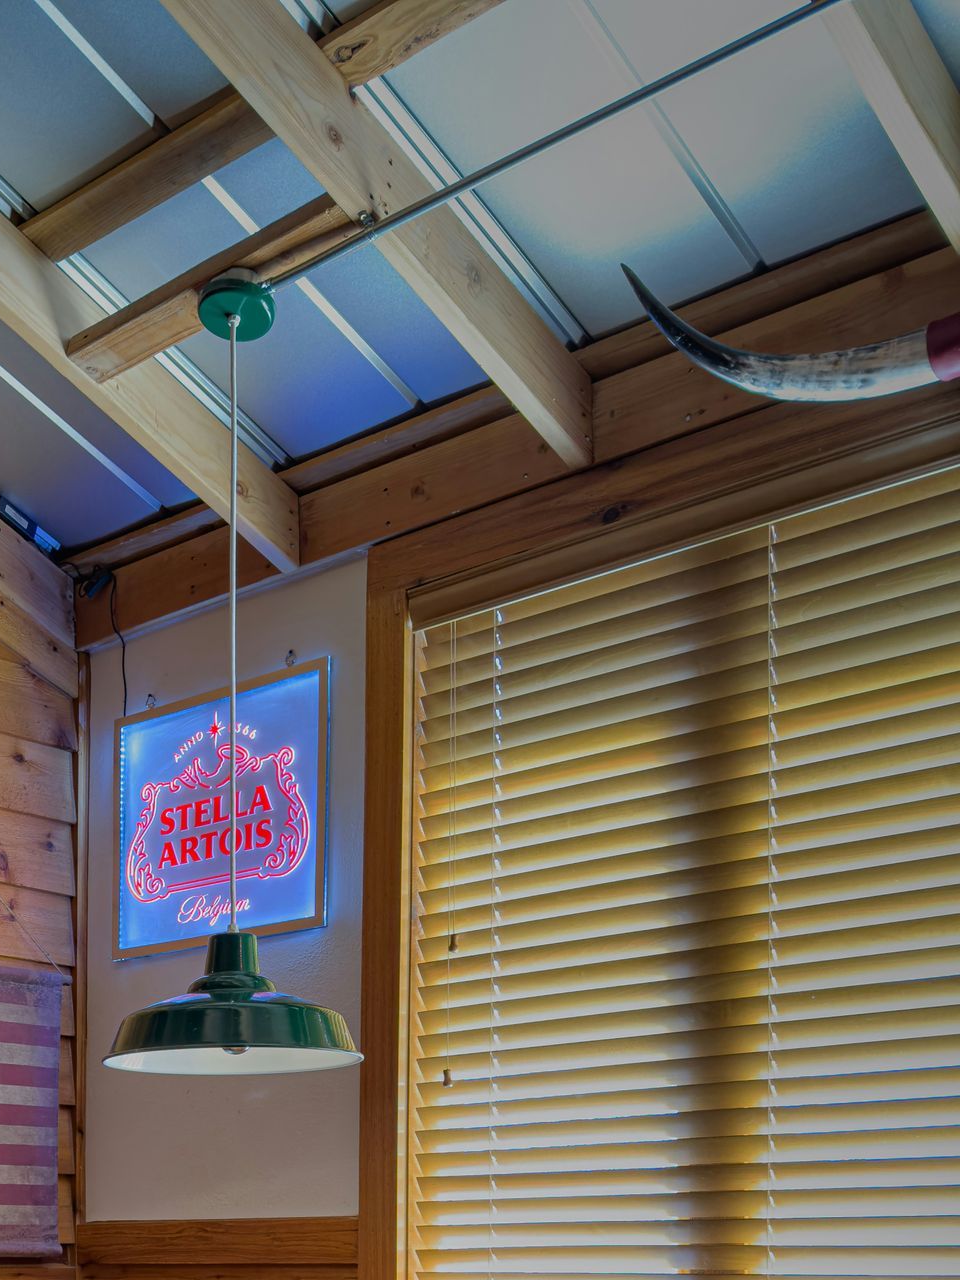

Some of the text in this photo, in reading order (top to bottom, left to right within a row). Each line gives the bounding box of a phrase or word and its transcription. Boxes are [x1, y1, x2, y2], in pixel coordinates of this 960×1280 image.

[174, 721, 257, 763] ANNO 366
[159, 785, 274, 836] STELLA
[157, 819, 274, 870] ARTOIS
